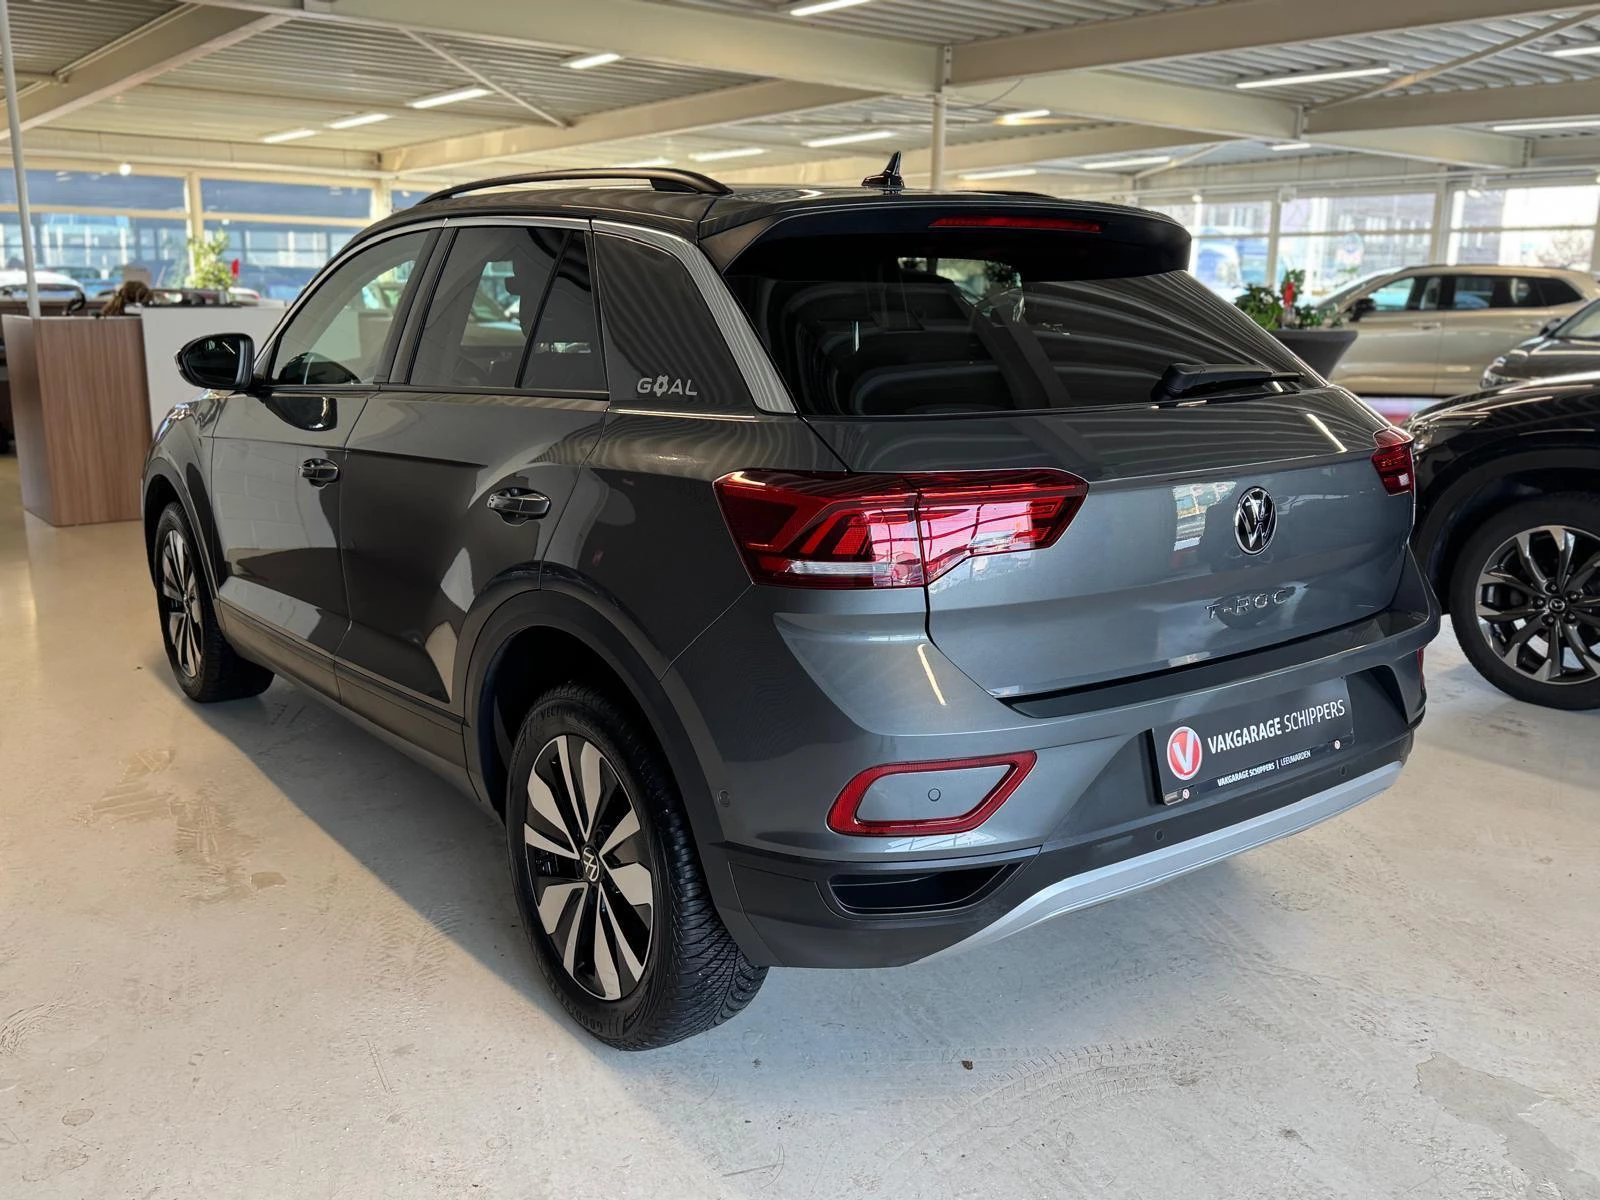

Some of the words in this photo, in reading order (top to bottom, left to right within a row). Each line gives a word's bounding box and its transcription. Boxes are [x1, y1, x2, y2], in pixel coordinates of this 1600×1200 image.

[636, 375, 698, 398] GOAL
[1205, 589, 1287, 619] T-ROC
[1207, 717, 1283, 755] VAKGARAGE
[1284, 699, 1346, 733] SCHIPPERS
[1217, 769, 1250, 787] VAKGARAGE
[1249, 762, 1275, 777] SCHIPPERS
[1280, 749, 1312, 767] LEEUWARDEN
